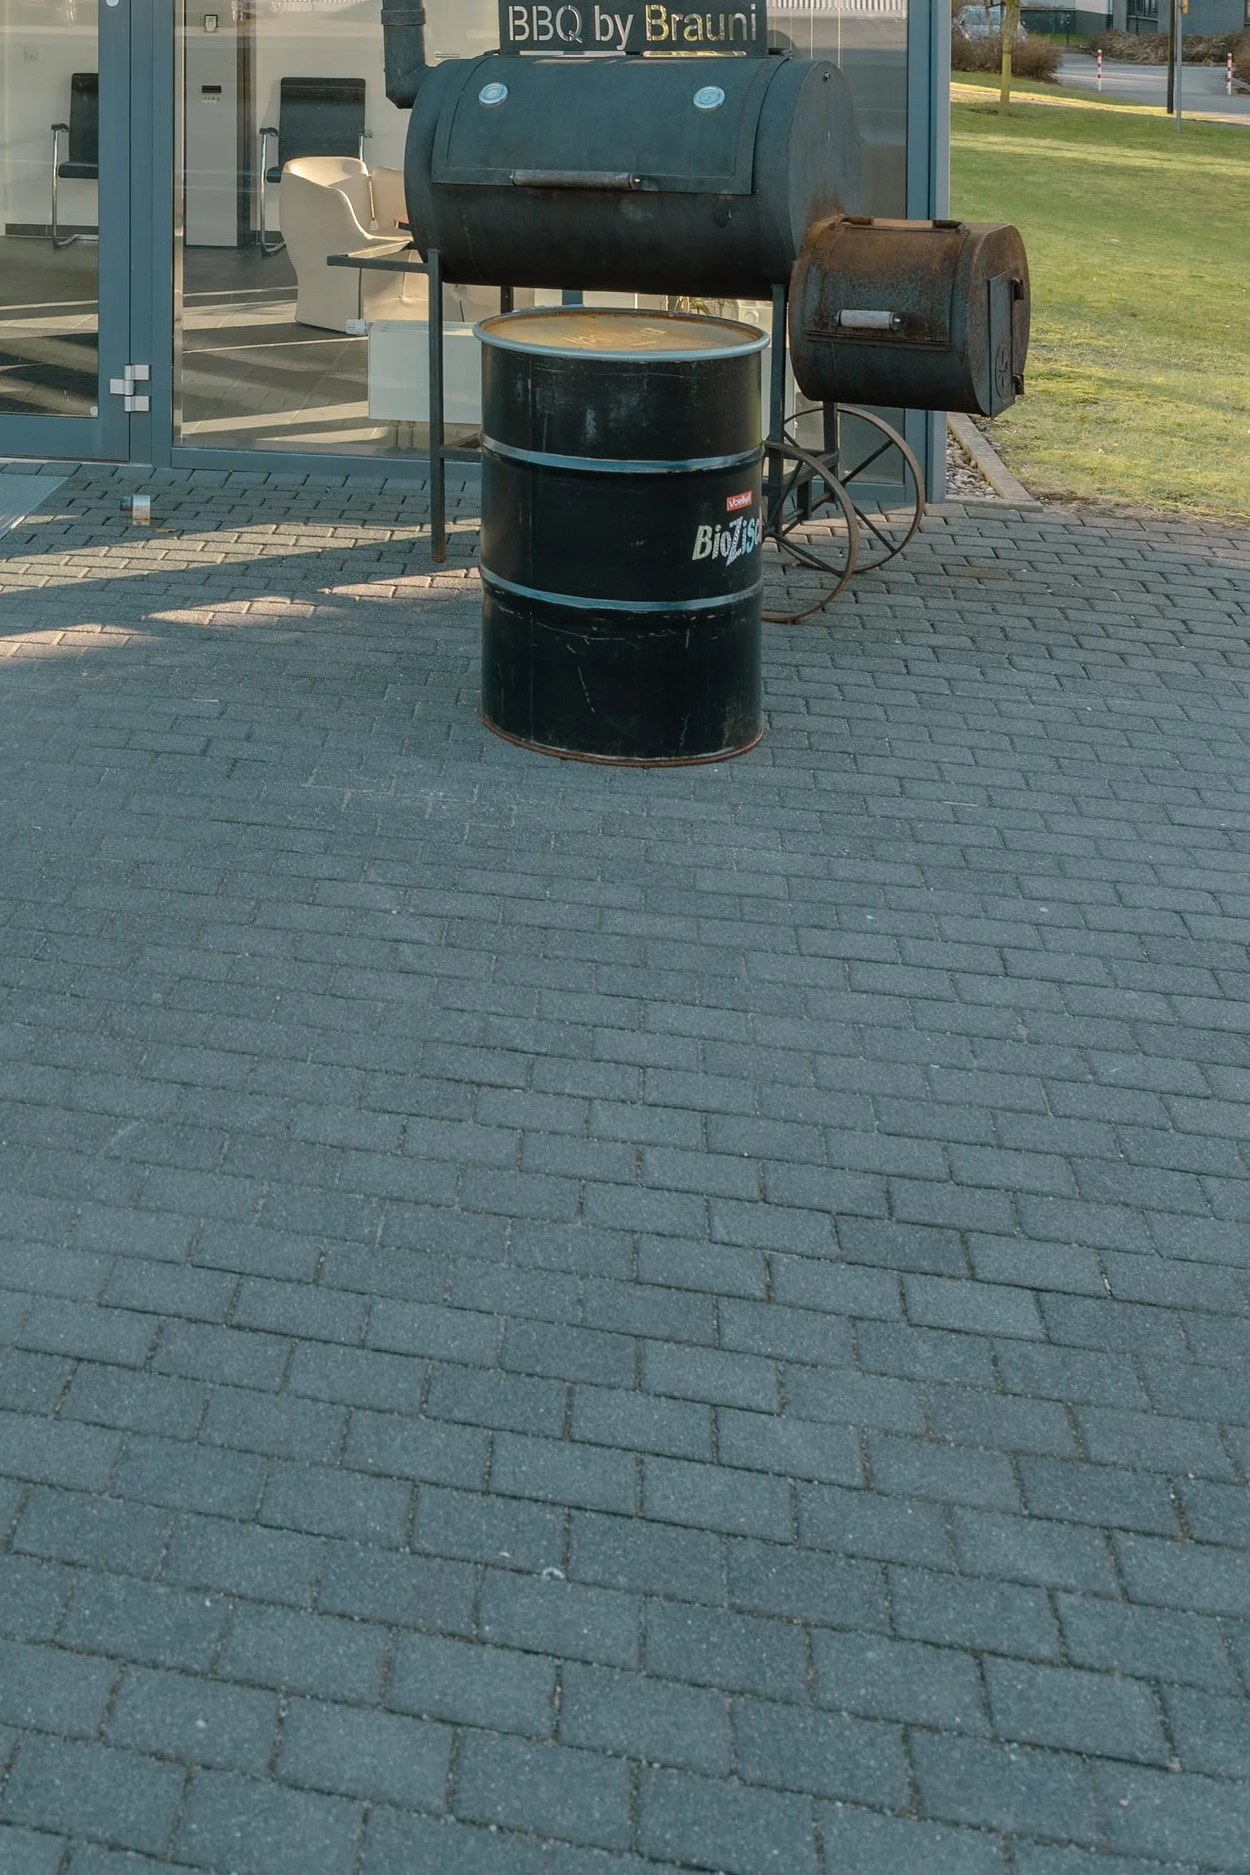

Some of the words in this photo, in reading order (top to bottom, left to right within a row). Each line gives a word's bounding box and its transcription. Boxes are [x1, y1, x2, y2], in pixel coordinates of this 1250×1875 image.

[508, 5, 583, 43] BBQ
[594, 5, 634, 50] by
[645, 4, 757, 42] Brauni
